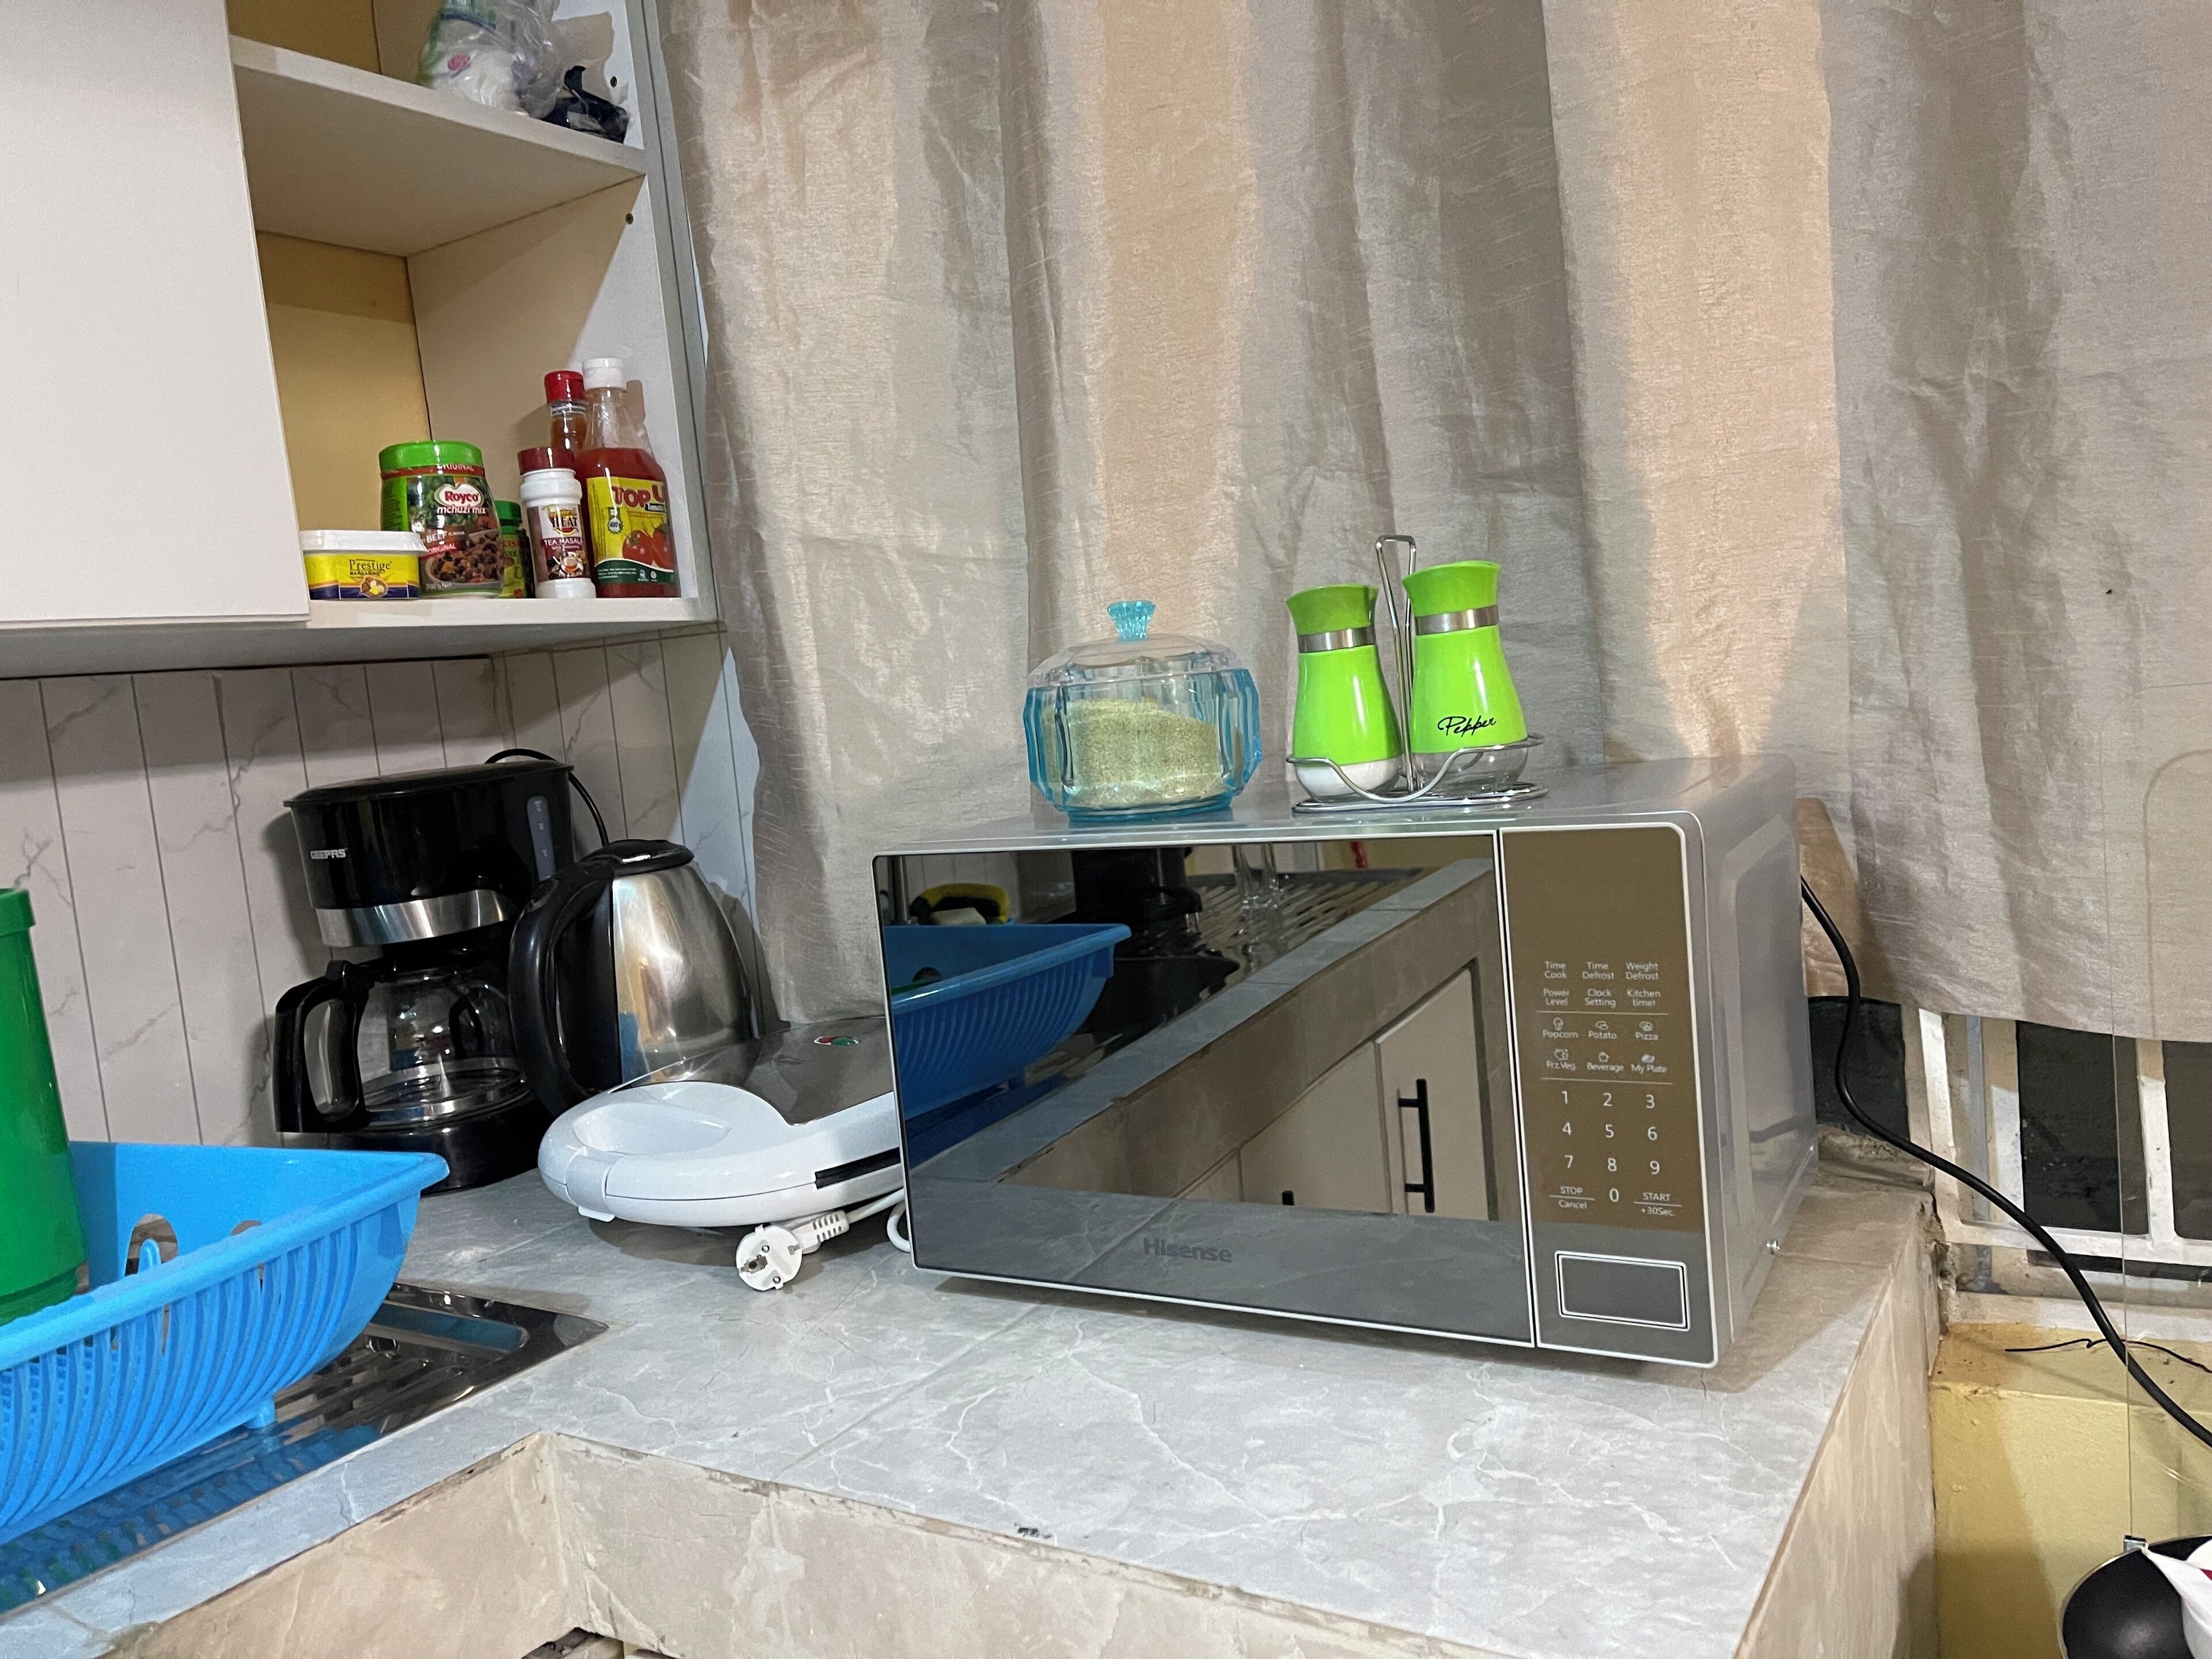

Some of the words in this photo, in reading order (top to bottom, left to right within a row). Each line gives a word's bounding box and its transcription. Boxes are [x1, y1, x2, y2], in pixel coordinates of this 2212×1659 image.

[444, 491, 479, 503] Royco
[612, 486, 651, 507] TOP
[438, 505, 470, 514] mchuzi
[552, 516, 577, 528] HEAT
[427, 543, 456, 554] ORIGINAL
[349, 559, 391, 573] Prestige
[1437, 715, 1497, 737] Pepper
[1544, 961, 1566, 969] Time
[1626, 961, 1658, 972] Weight
[1544, 971, 1567, 979] Cook
[1582, 971, 1615, 979] Defrost
[1626, 971, 1659, 980] Defrost
[1543, 988, 1569, 997] Power
[1588, 988, 1611, 997] Clock
[1627, 988, 1660, 998] Kitchen
[1546, 997, 1568, 1005] Level
[1585, 998, 1616, 1007] Setting
[1633, 998, 1656, 1006] timer
[1542, 1029, 1578, 1039] Popcorn
[1588, 1031, 1617, 1039] Potato
[1635, 1032, 1658, 1040] Pizza
[1587, 1062, 1624, 1073] Beverage
[1631, 1065, 1645, 1073] My
[1561, 1090, 1568, 1104] 1
[1603, 1093, 1612, 1107] 2
[1646, 1094, 1655, 1108] 3
[1562, 1122, 1573, 1135] 4
[1605, 1124, 1614, 1138] 5
[1647, 1126, 1658, 1141] 6
[1564, 1154, 1574, 1169] 7
[1607, 1157, 1617, 1172] 8
[1650, 1161, 1660, 1175] 9
[1560, 1186, 1583, 1194] STOP
[1609, 1188, 1619, 1202] 0
[1643, 1192, 1671, 1202] START
[1558, 1200, 1587, 1209] Cancel
[1143, 1237, 1232, 1263] Hisense
